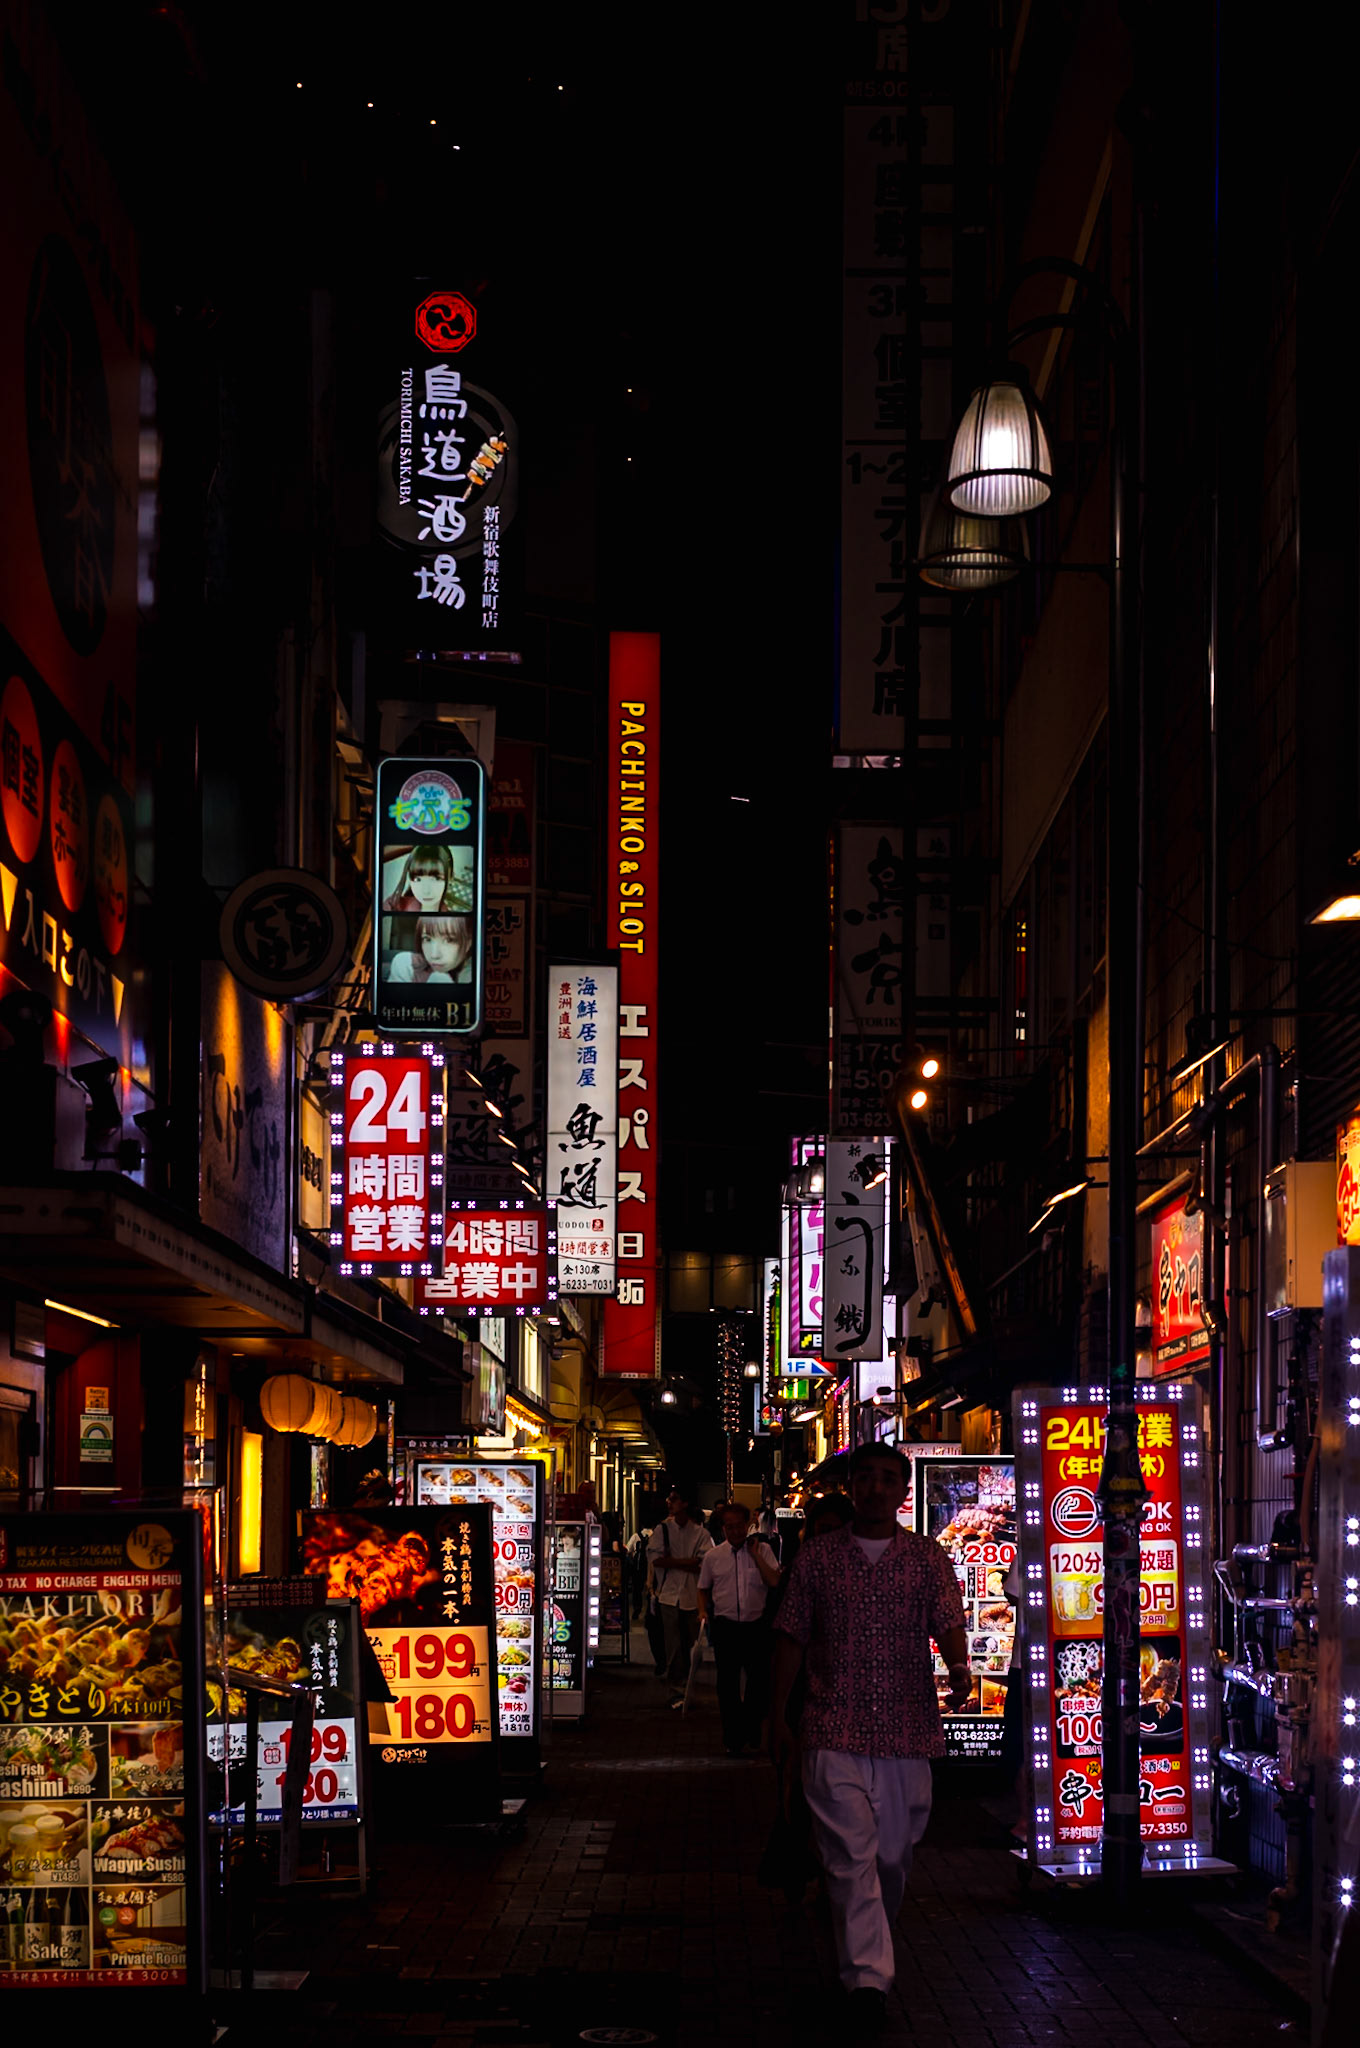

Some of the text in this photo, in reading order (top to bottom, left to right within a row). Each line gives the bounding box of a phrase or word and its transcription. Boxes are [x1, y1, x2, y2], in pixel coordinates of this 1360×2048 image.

[399, 367, 413, 505] TORIMICHI SAKABA
[413, 364, 468, 610] 鳥道酒場
[480, 505, 500, 629] 新宿歌舞伎町店
[619, 701, 646, 955] PACHINKO & SLOT
[446, 1003, 472, 1027] B1
[577, 976, 598, 1088] 海鮮居酒屋
[349, 1069, 427, 1144] 24
[348, 1153, 425, 1201] 時間
[347, 1203, 426, 1251] 営業
[424, 1261, 538, 1299] 営業中
[1155, 1522, 1171, 1532] OK
[966, 1545, 1015, 1563] 280
[36, 1575, 53, 1588] NO
[54, 1575, 98, 1588] CHARGE
[103, 1573, 150, 1587] ENGLISH
[152, 1572, 183, 1586] MENU
[0, 1594, 162, 1618] YAKITORI
[21, 1763, 45, 1776] Fish
[94, 1856, 186, 1873] Wagyu Sushi
[30, 1943, 70, 1959] Sake
[111, 1953, 155, 1966] Private
